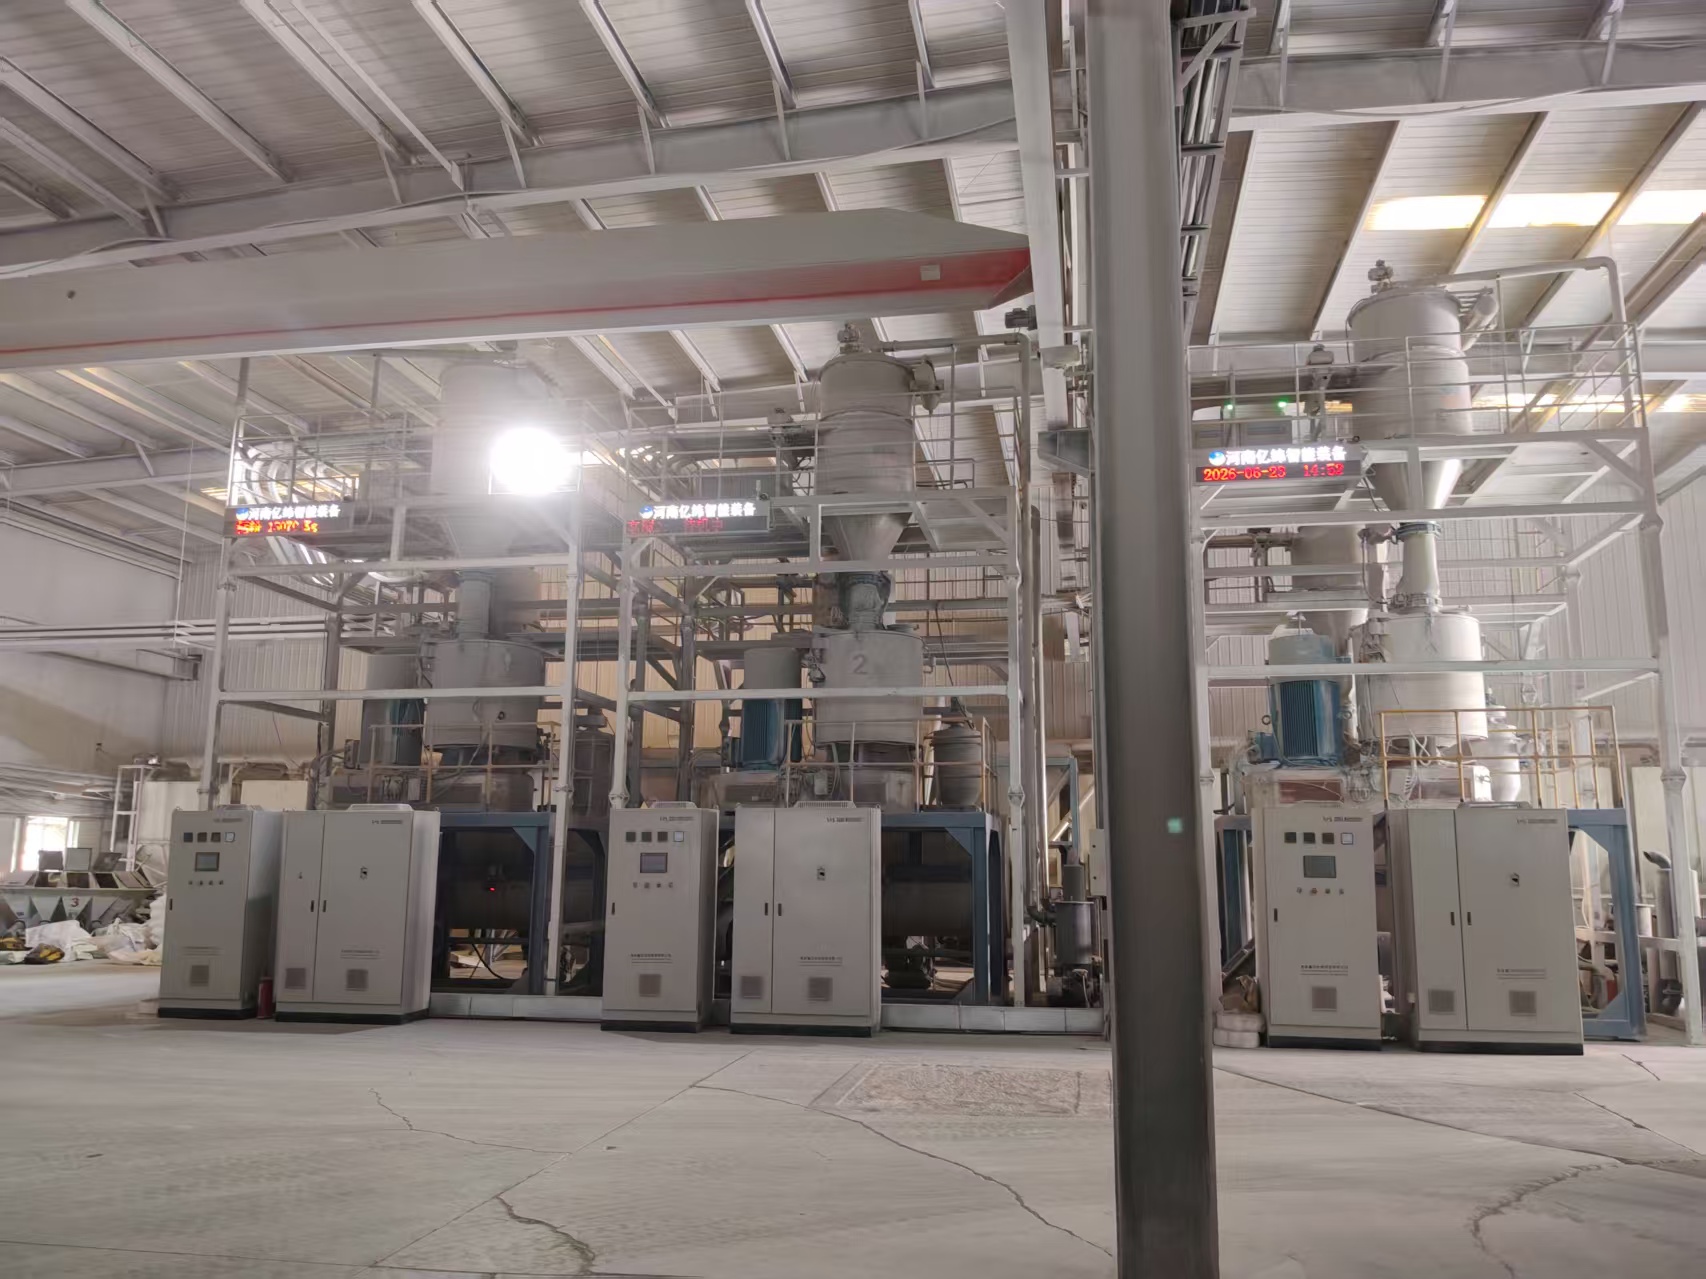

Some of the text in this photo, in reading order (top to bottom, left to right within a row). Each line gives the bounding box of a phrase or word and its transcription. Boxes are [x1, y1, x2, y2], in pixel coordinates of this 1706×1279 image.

[1303, 463, 1345, 478] 14:52
[852, 654, 868, 675] 2
[71, 897, 79, 907] 3
